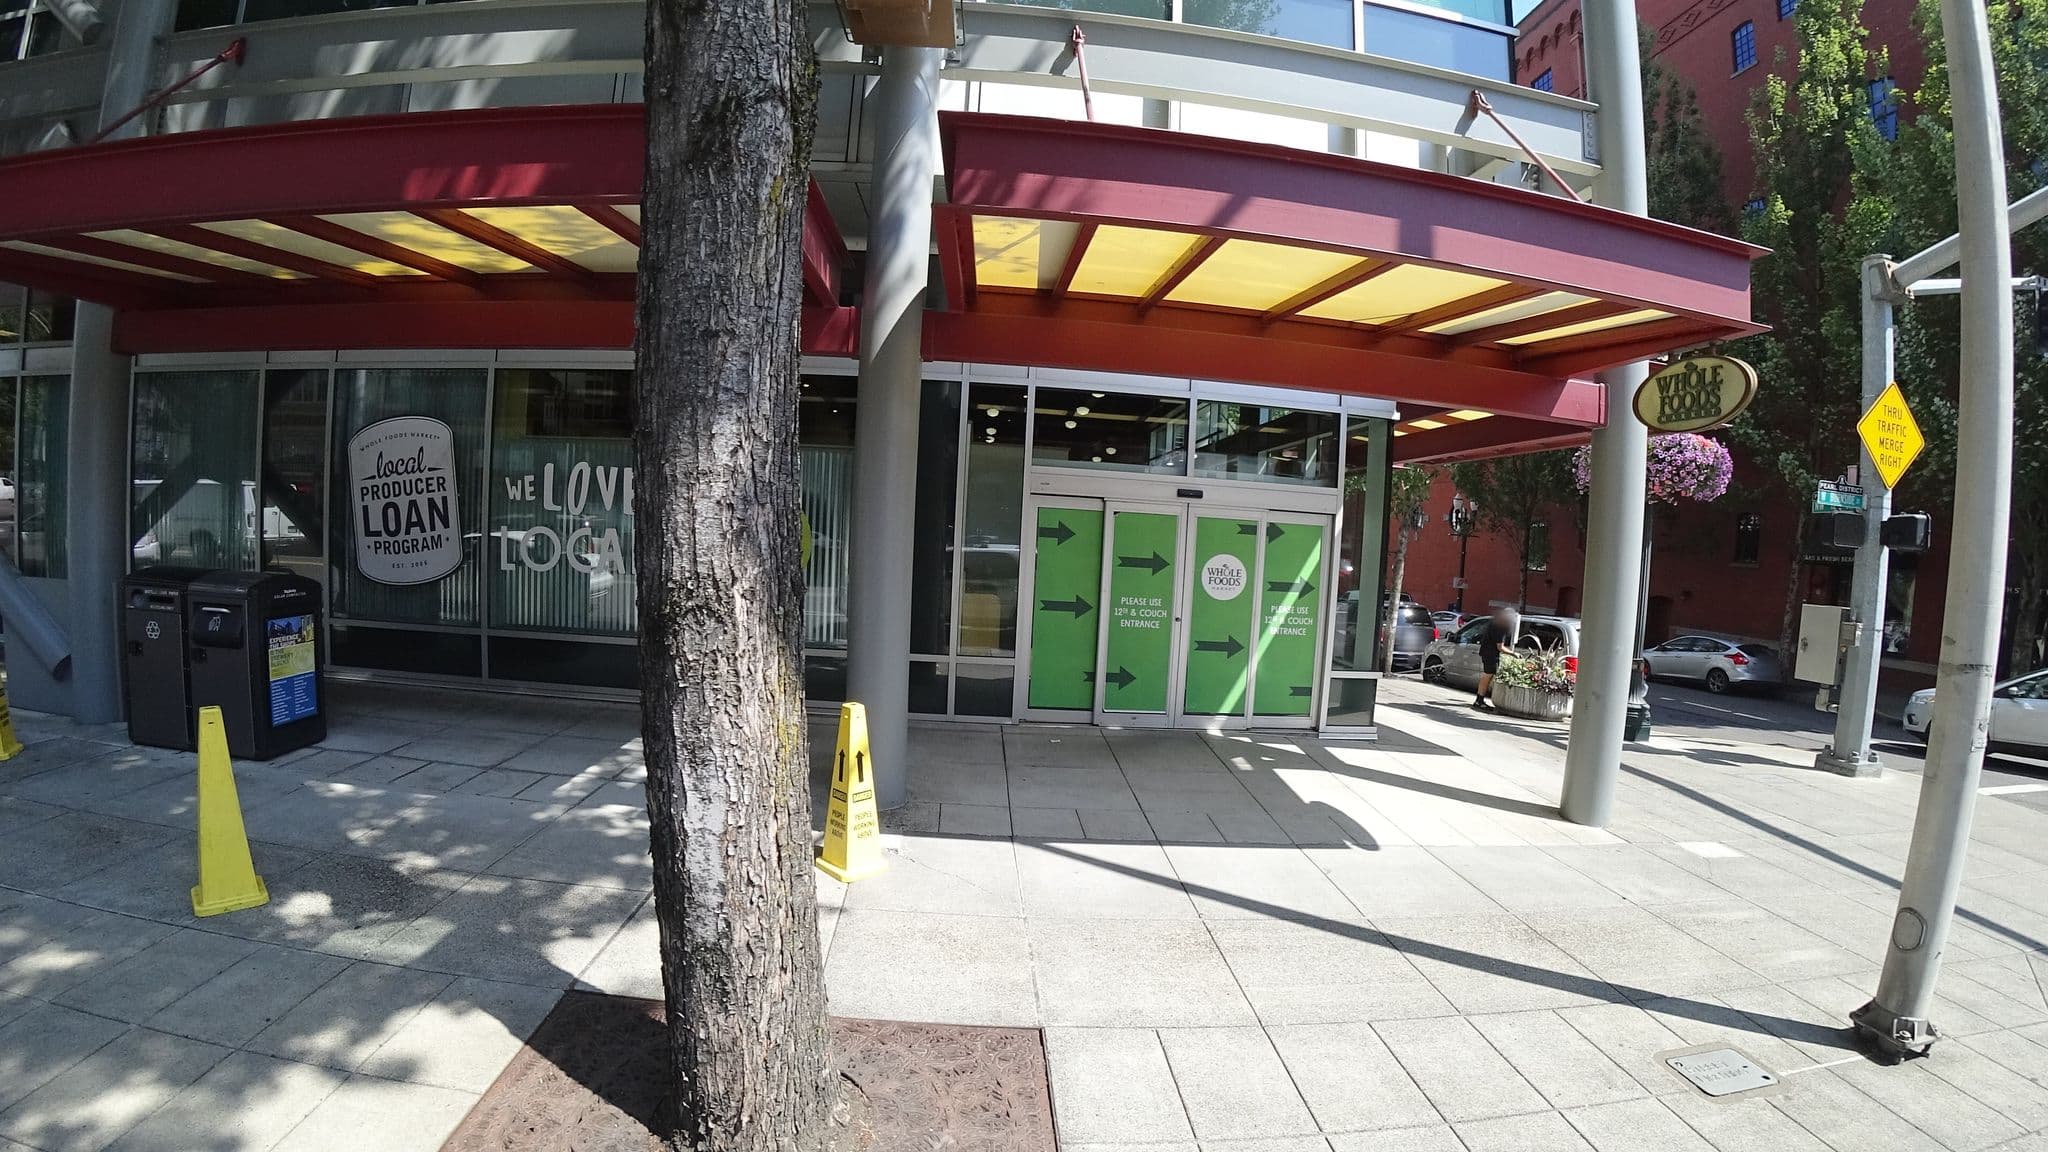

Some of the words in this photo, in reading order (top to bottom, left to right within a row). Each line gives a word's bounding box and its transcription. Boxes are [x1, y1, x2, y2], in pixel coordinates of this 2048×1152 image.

[1655, 364, 1724, 397] WHOLE
[1659, 386, 1722, 416] FOODS
[1882, 404, 1903, 420] THRU
[1877, 419, 1907, 438] TRAFFIC
[360, 438, 382, 452] WHOLE
[384, 432, 408, 441] FOODS
[1879, 436, 1905, 454] MERGE
[376, 446, 427, 479] local
[1879, 453, 1902, 469] RIGHT
[361, 476, 447, 502] PRODUCER
[505, 475, 536, 501] WE
[1819, 482, 1838, 491] PEARL
[1838, 485, 1864, 495] DISTRICT
[362, 495, 450, 538] LOAN
[373, 534, 443, 555] PROGRAM
[500, 525, 637, 575] LOCA
[1207, 567, 1243, 578] WHOLE
[1208, 576, 1241, 587] FOODS
[1120, 596, 1148, 606] PLEASE
[1149, 598, 1163, 607] USE
[1130, 608, 1137, 617] &
[1139, 609, 1168, 618] COUCH
[1296, 606, 1309, 615] USE
[1120, 619, 1161, 629] ENTRANCE
[1287, 616, 1314, 625] COUCH
[1269, 626, 1308, 636] ENTRANCE
